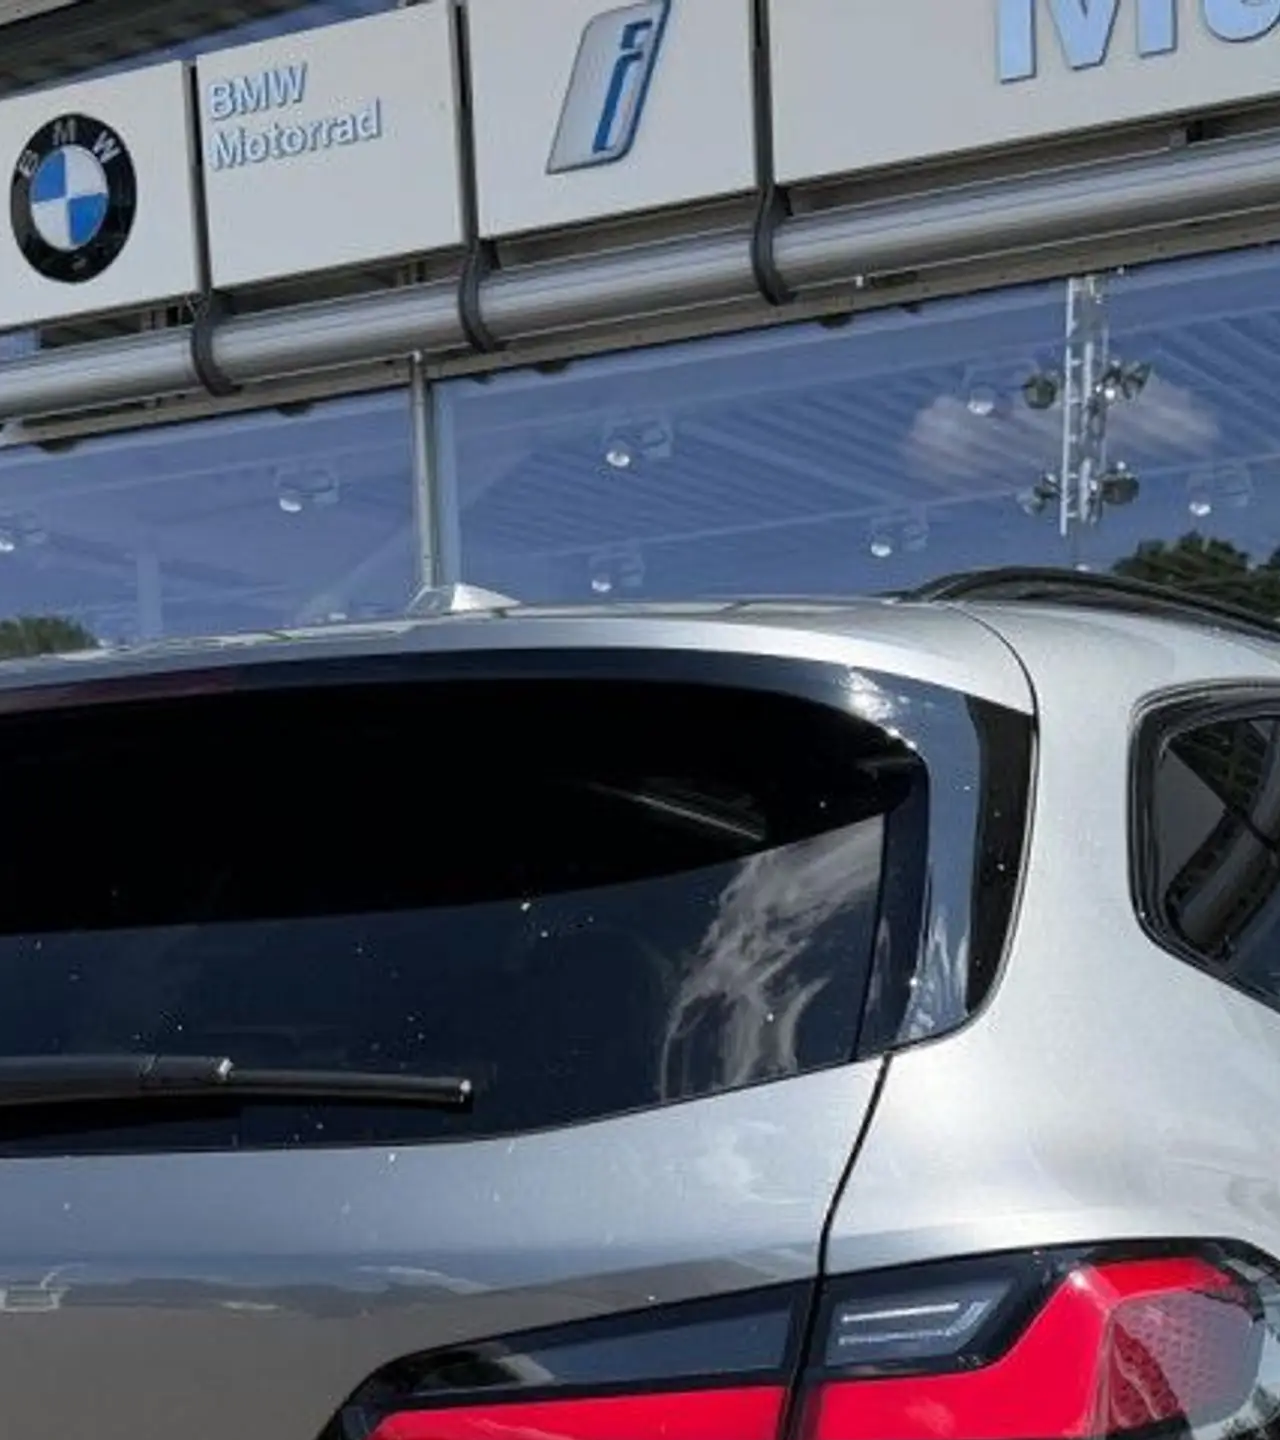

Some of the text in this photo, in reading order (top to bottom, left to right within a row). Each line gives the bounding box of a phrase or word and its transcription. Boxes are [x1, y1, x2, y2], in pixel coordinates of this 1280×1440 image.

[210, 62, 307, 121] BMW
[18, 119, 120, 178] BMW
[210, 97, 382, 172] Motorrad
